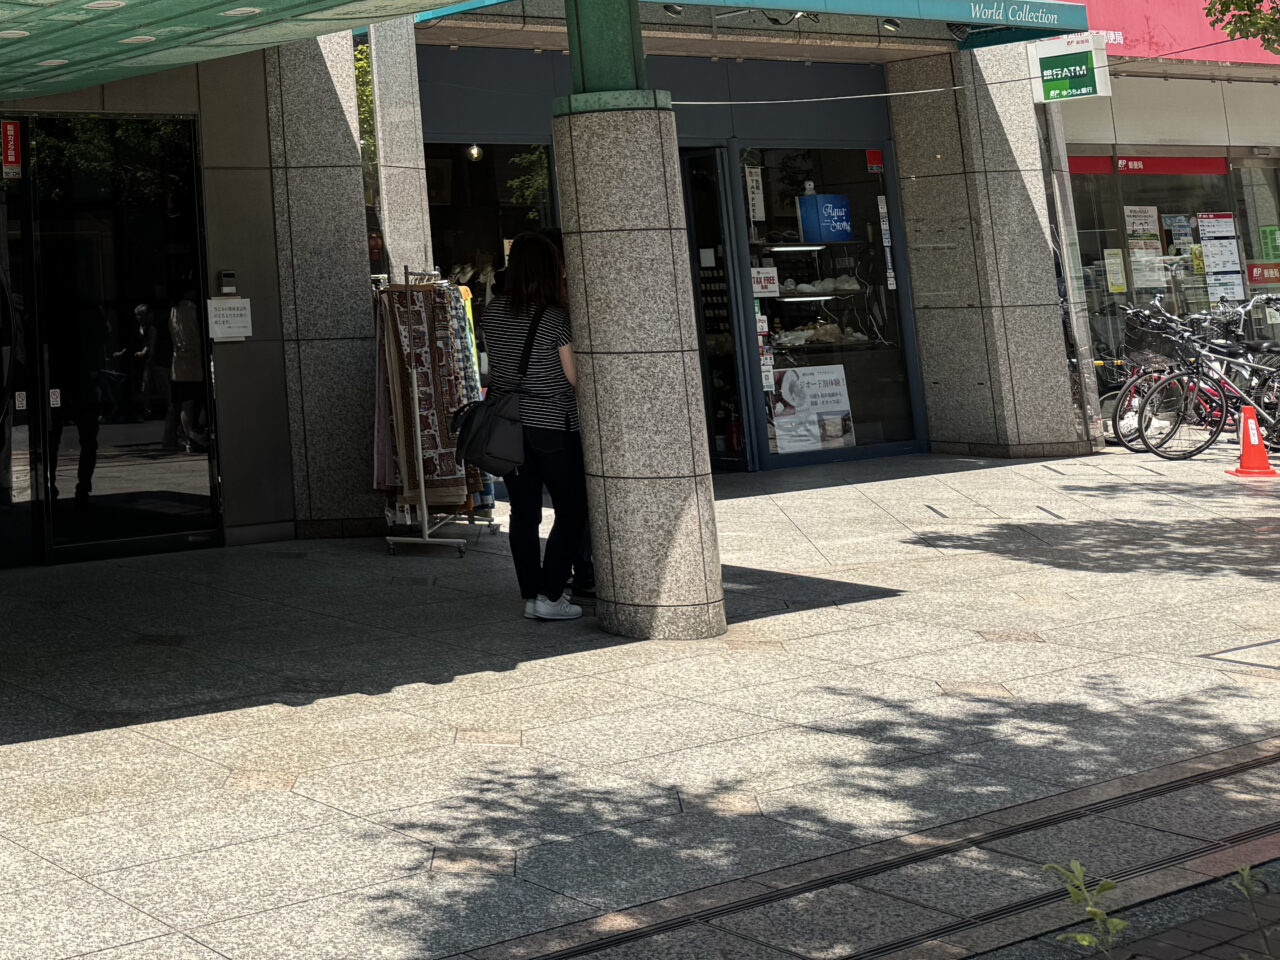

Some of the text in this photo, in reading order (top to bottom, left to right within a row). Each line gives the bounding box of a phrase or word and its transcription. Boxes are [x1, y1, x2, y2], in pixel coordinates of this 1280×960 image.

[970, 2, 1058, 24] World Collection
[1044, 65, 1086, 80] 銀行ATM
[1062, 86, 1092, 96] ゆうちょ銀行
[752, 276, 776, 284] TAX FREE
